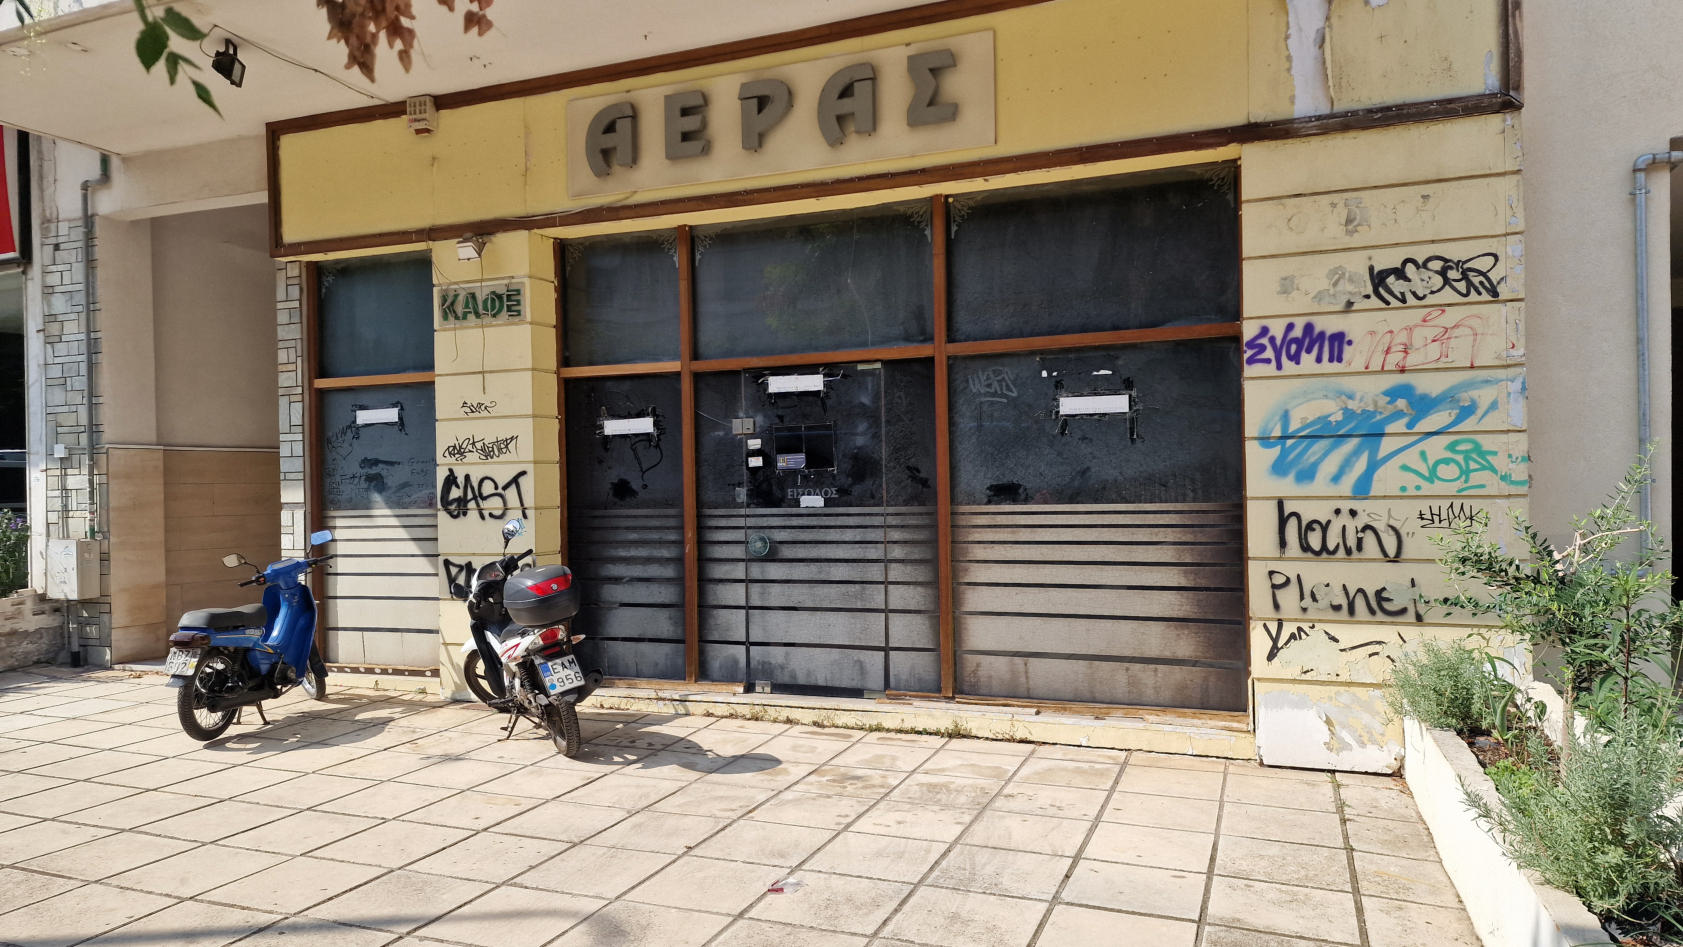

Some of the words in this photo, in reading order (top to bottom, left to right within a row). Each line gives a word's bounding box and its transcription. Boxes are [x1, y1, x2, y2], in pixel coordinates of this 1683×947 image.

[585, 48, 958, 178] ΑΕΡΑΣ
[440, 288, 522, 322] ΚΑΦΕ
[557, 671, 583, 688] 956
